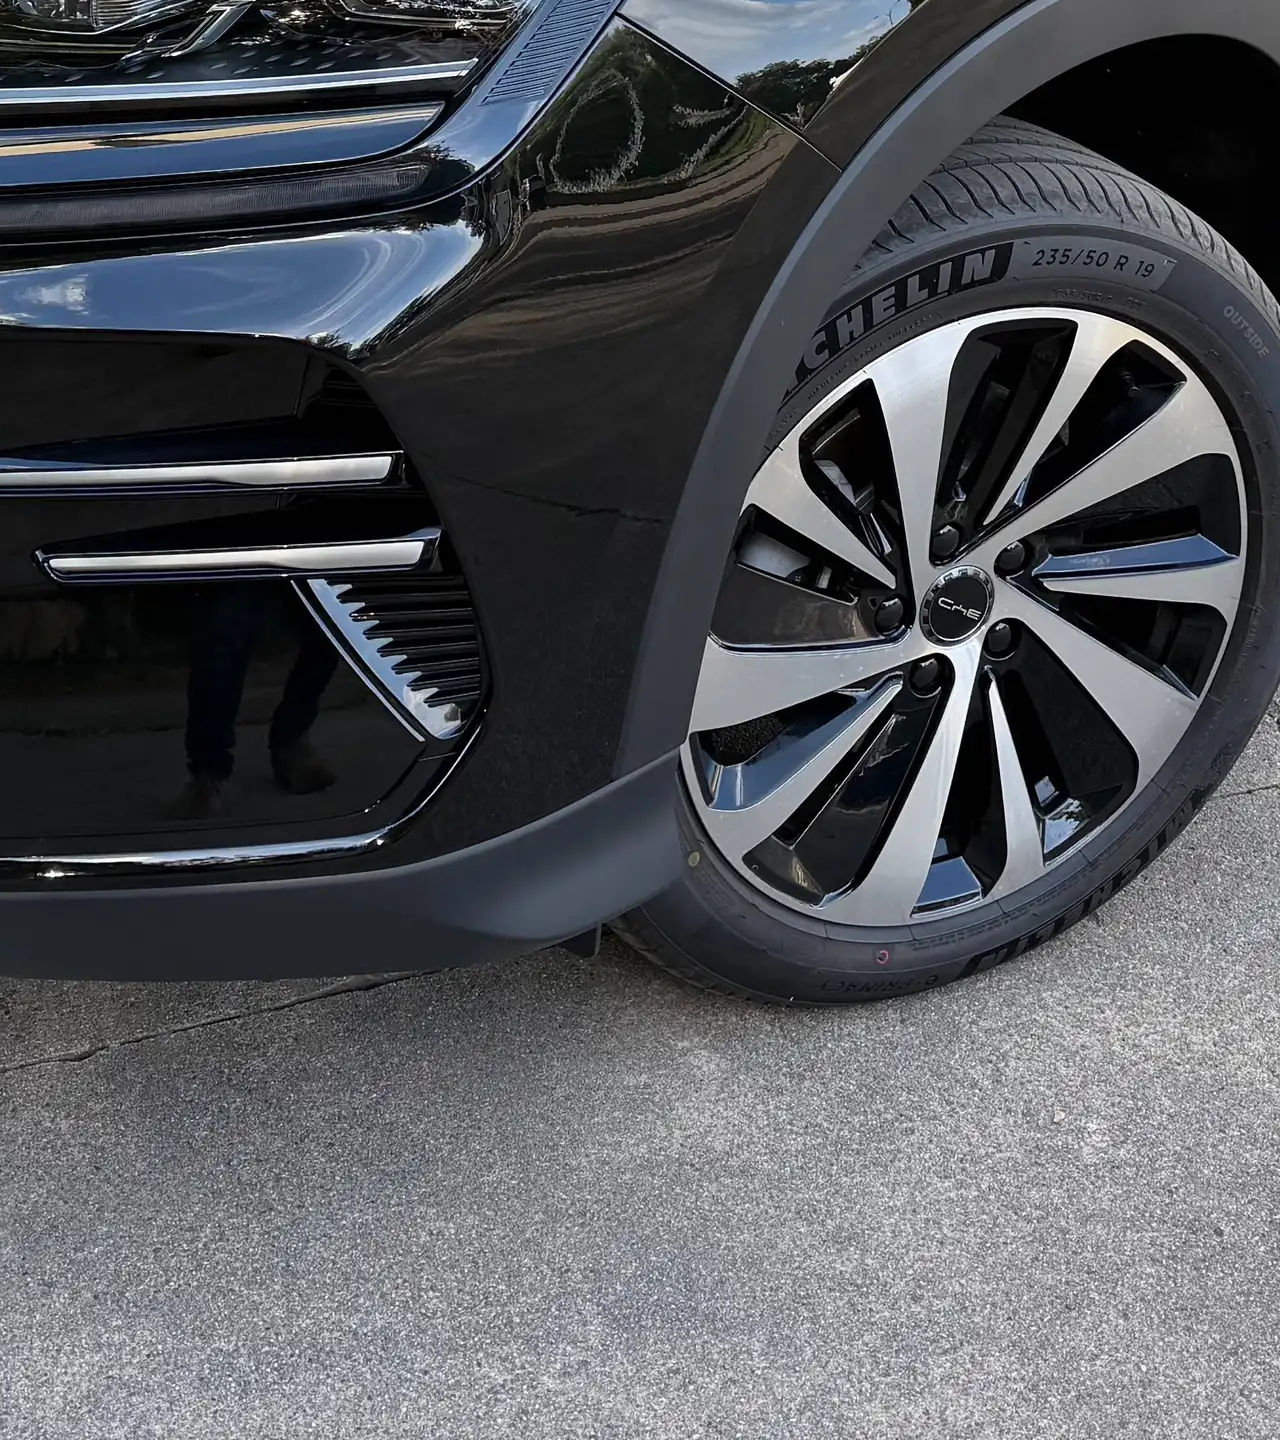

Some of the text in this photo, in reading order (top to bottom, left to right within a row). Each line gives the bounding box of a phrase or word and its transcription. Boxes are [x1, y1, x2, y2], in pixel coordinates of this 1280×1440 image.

[803, 247, 1156, 370] CHELIN 235/50 R 19
[1223, 305, 1269, 359] OUTSIDE
